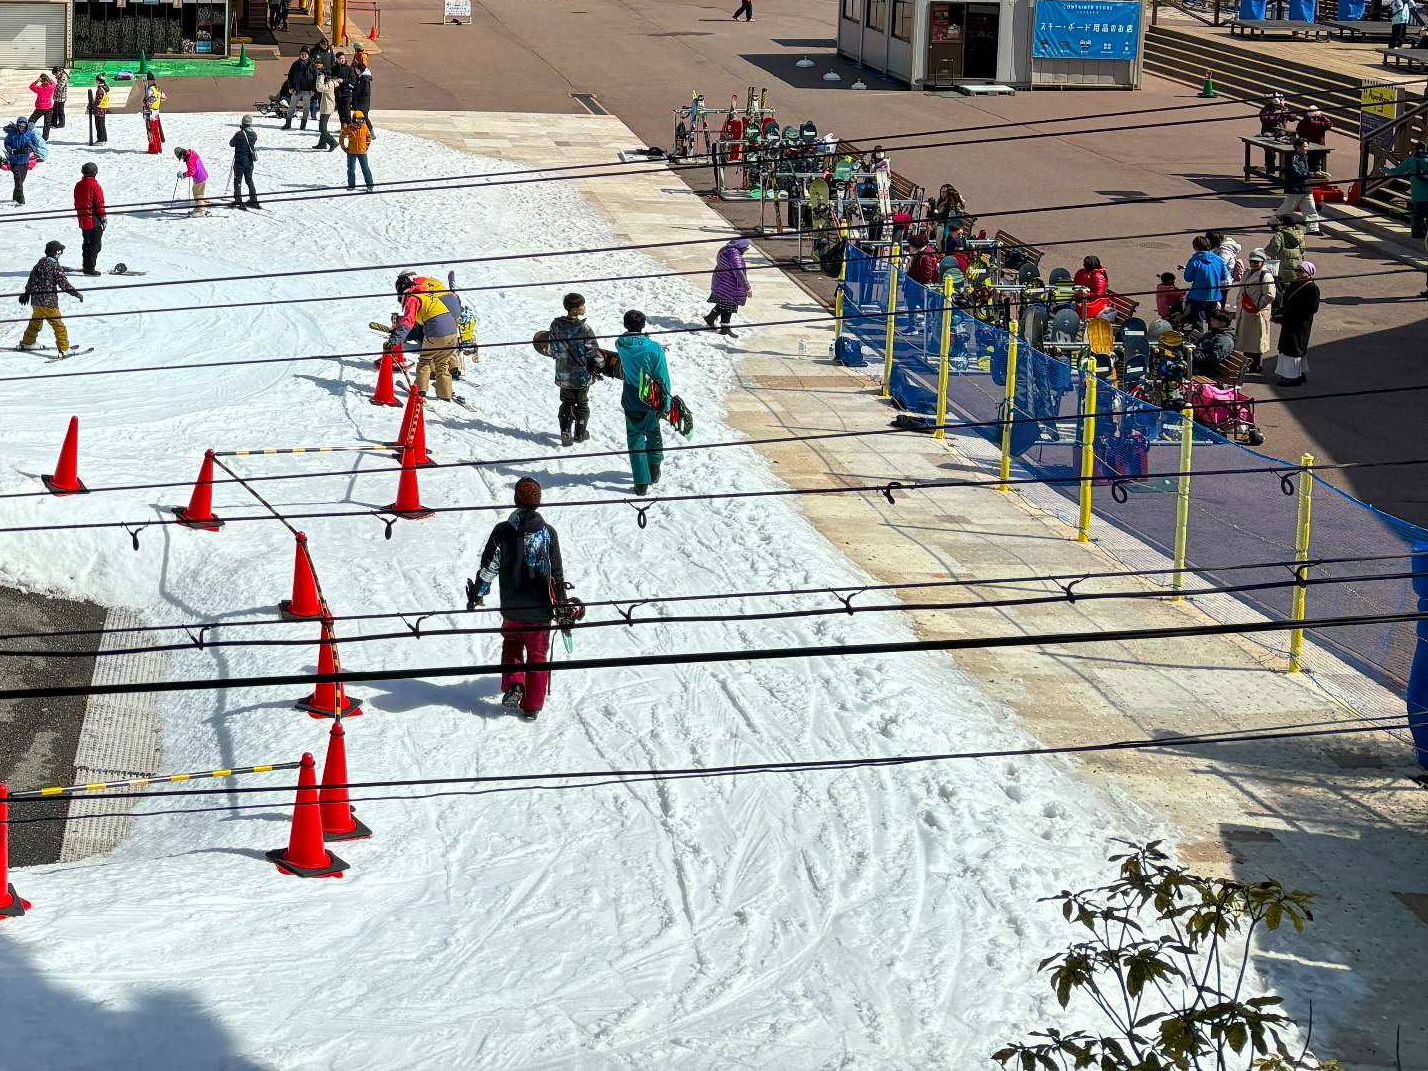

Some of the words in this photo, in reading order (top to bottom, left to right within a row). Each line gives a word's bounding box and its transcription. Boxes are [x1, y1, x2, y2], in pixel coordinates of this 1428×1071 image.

[1040, 21, 1134, 34] スキー・ボード用品のお店
